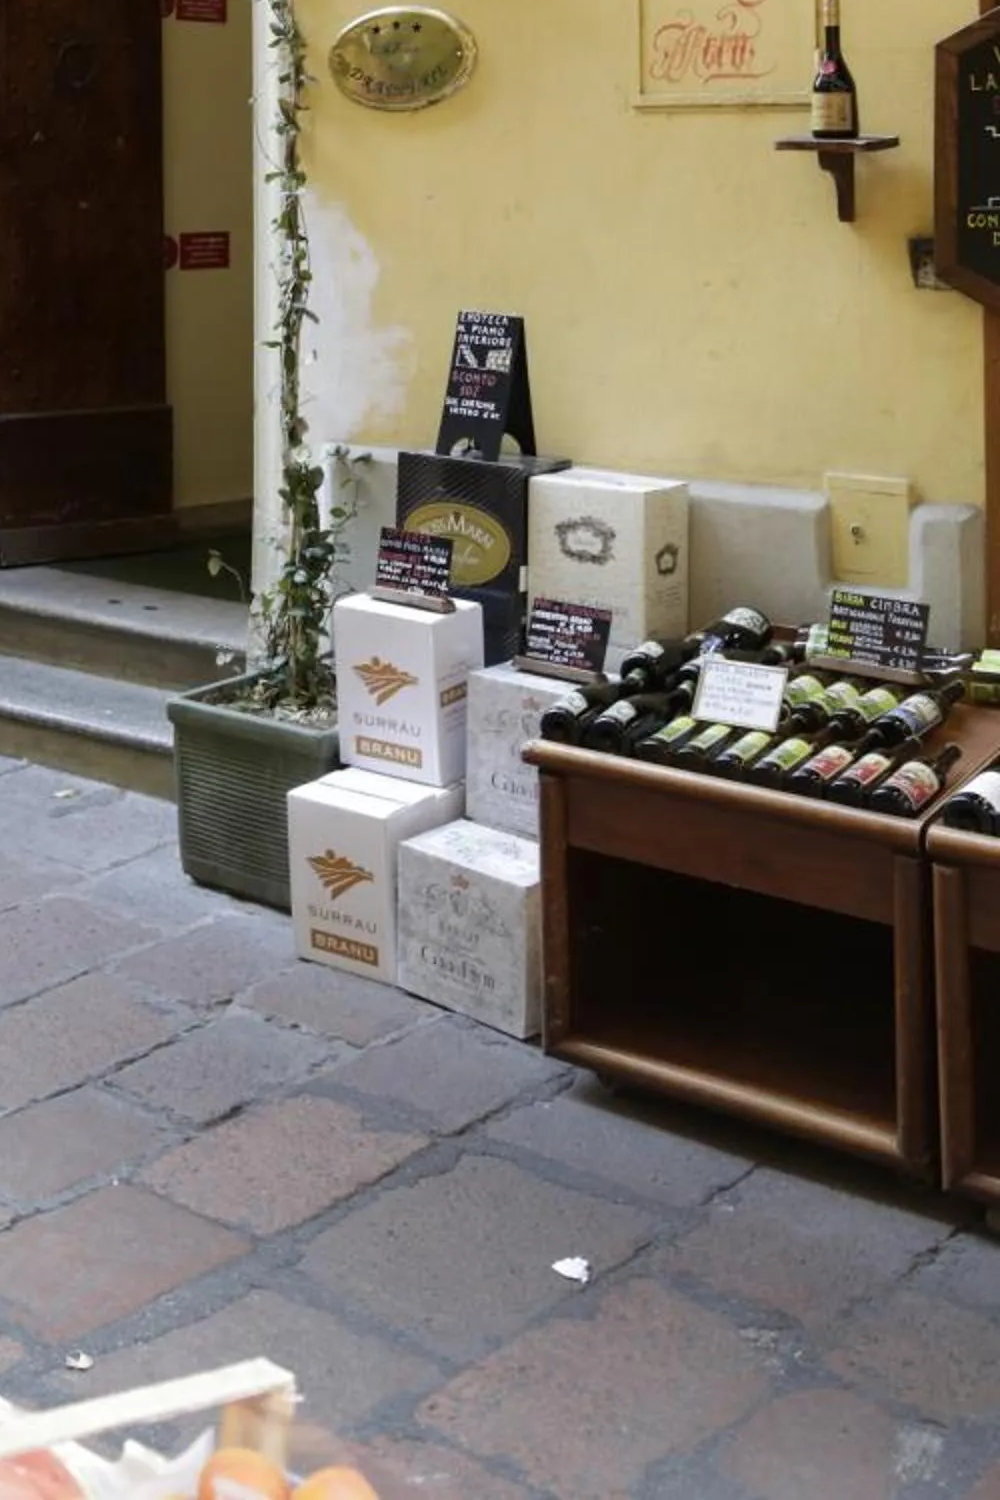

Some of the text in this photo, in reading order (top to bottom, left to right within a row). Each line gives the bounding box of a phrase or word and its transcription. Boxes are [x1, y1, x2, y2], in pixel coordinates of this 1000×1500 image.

[353, 712, 422, 738] SURRAU
[359, 739, 420, 764] BRANU
[307, 904, 378, 935] SURRAU
[315, 935, 375, 962] BRANU
